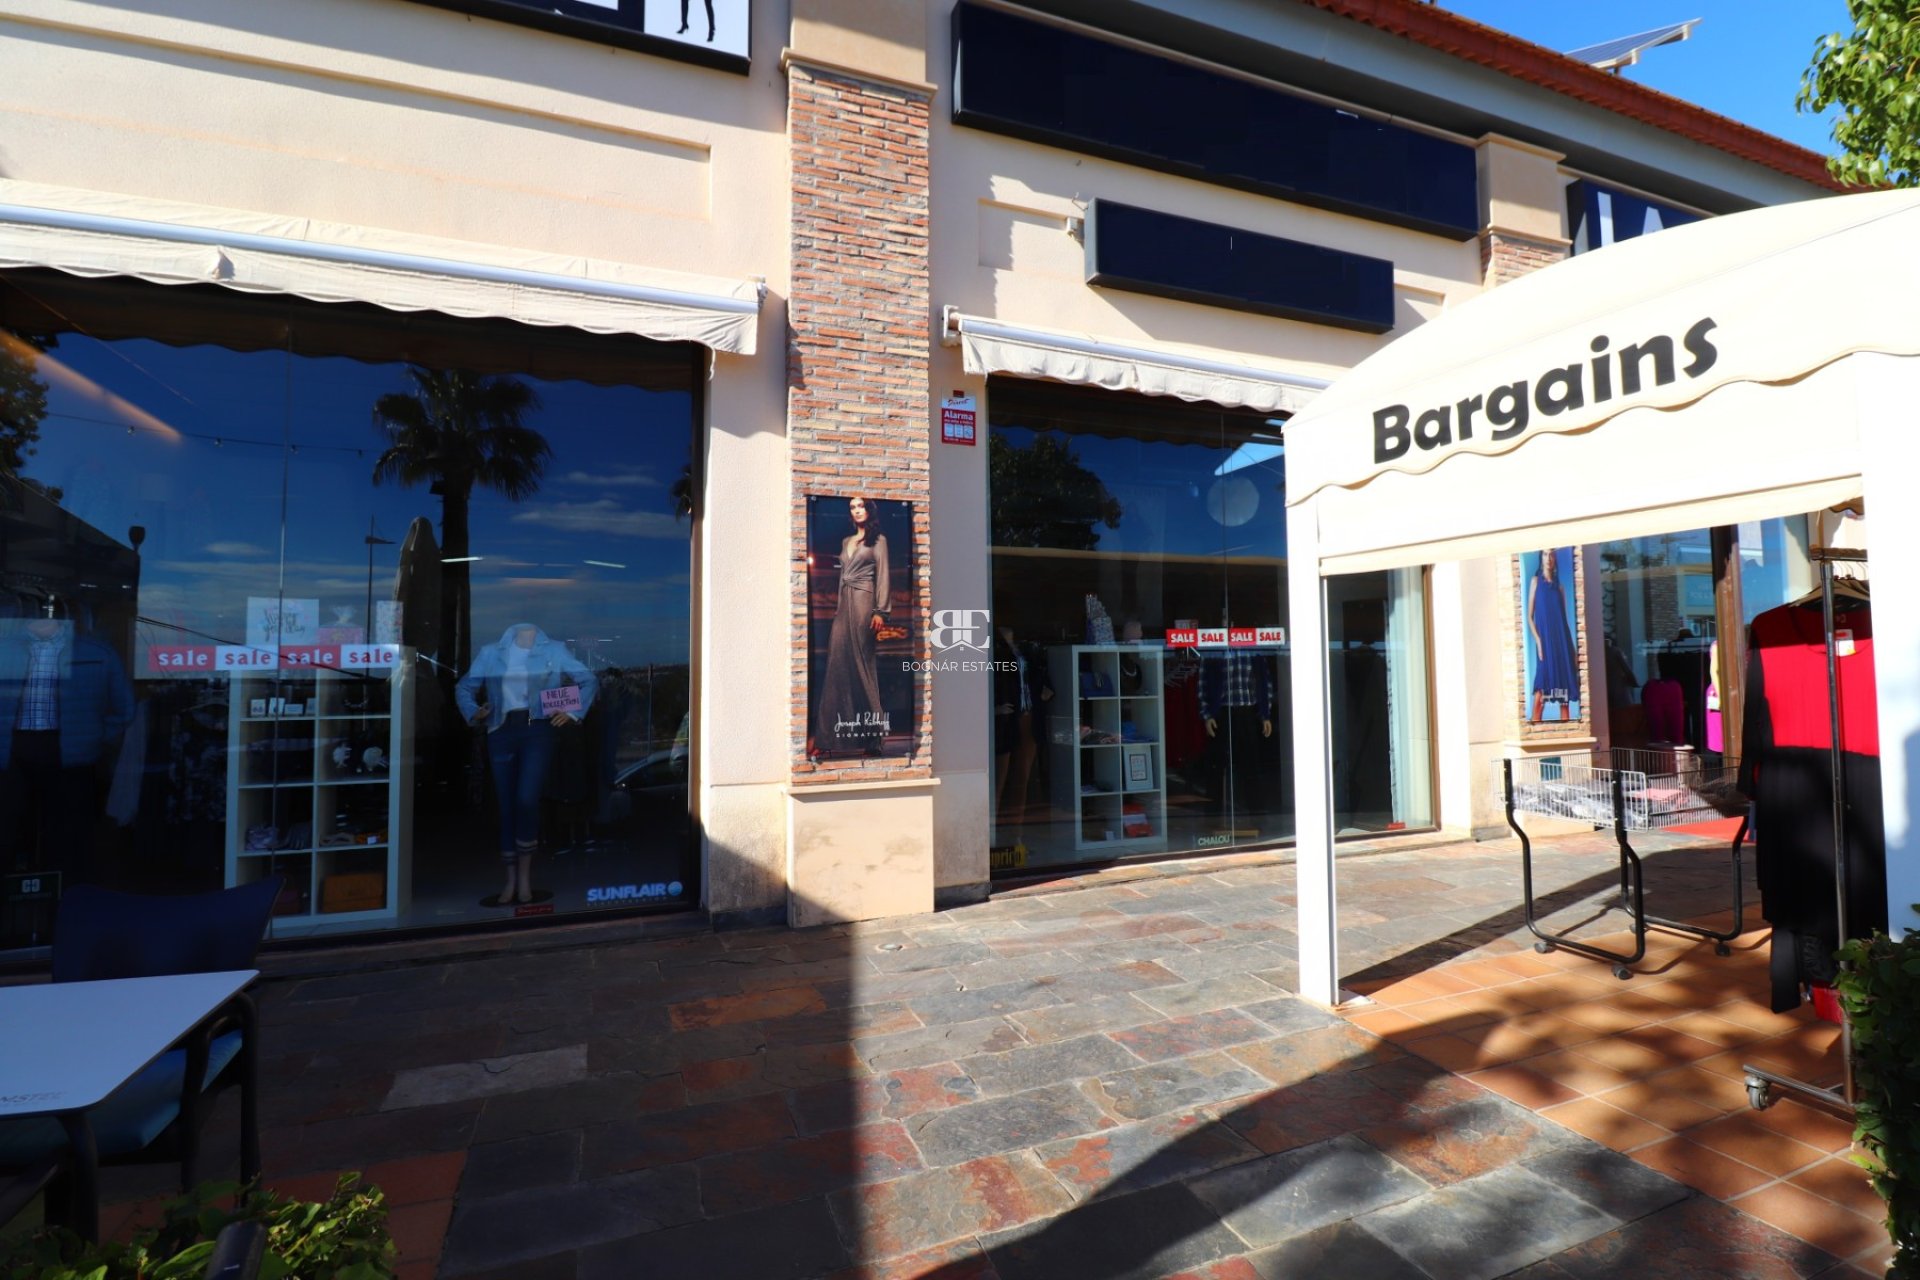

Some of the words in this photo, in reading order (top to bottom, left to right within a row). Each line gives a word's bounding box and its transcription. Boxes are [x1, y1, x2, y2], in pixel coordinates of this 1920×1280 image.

[1373, 317, 1718, 464] Bargains
[944, 410, 974, 421] Alarma
[1171, 633, 1195, 643] SALE
[1201, 633, 1225, 643] SALE
[1231, 632, 1254, 642] SALE
[1260, 631, 1282, 641] SALE
[158, 648, 208, 667] sale
[224, 648, 272, 666] sale
[287, 648, 334, 664] sale
[349, 647, 393, 664] sale
[546, 688, 570, 698] NEUE
[834, 712, 861, 732] Joseph
[1198, 833, 1230, 846] CHALOU
[587, 883, 666, 901] SUNFLAIR
